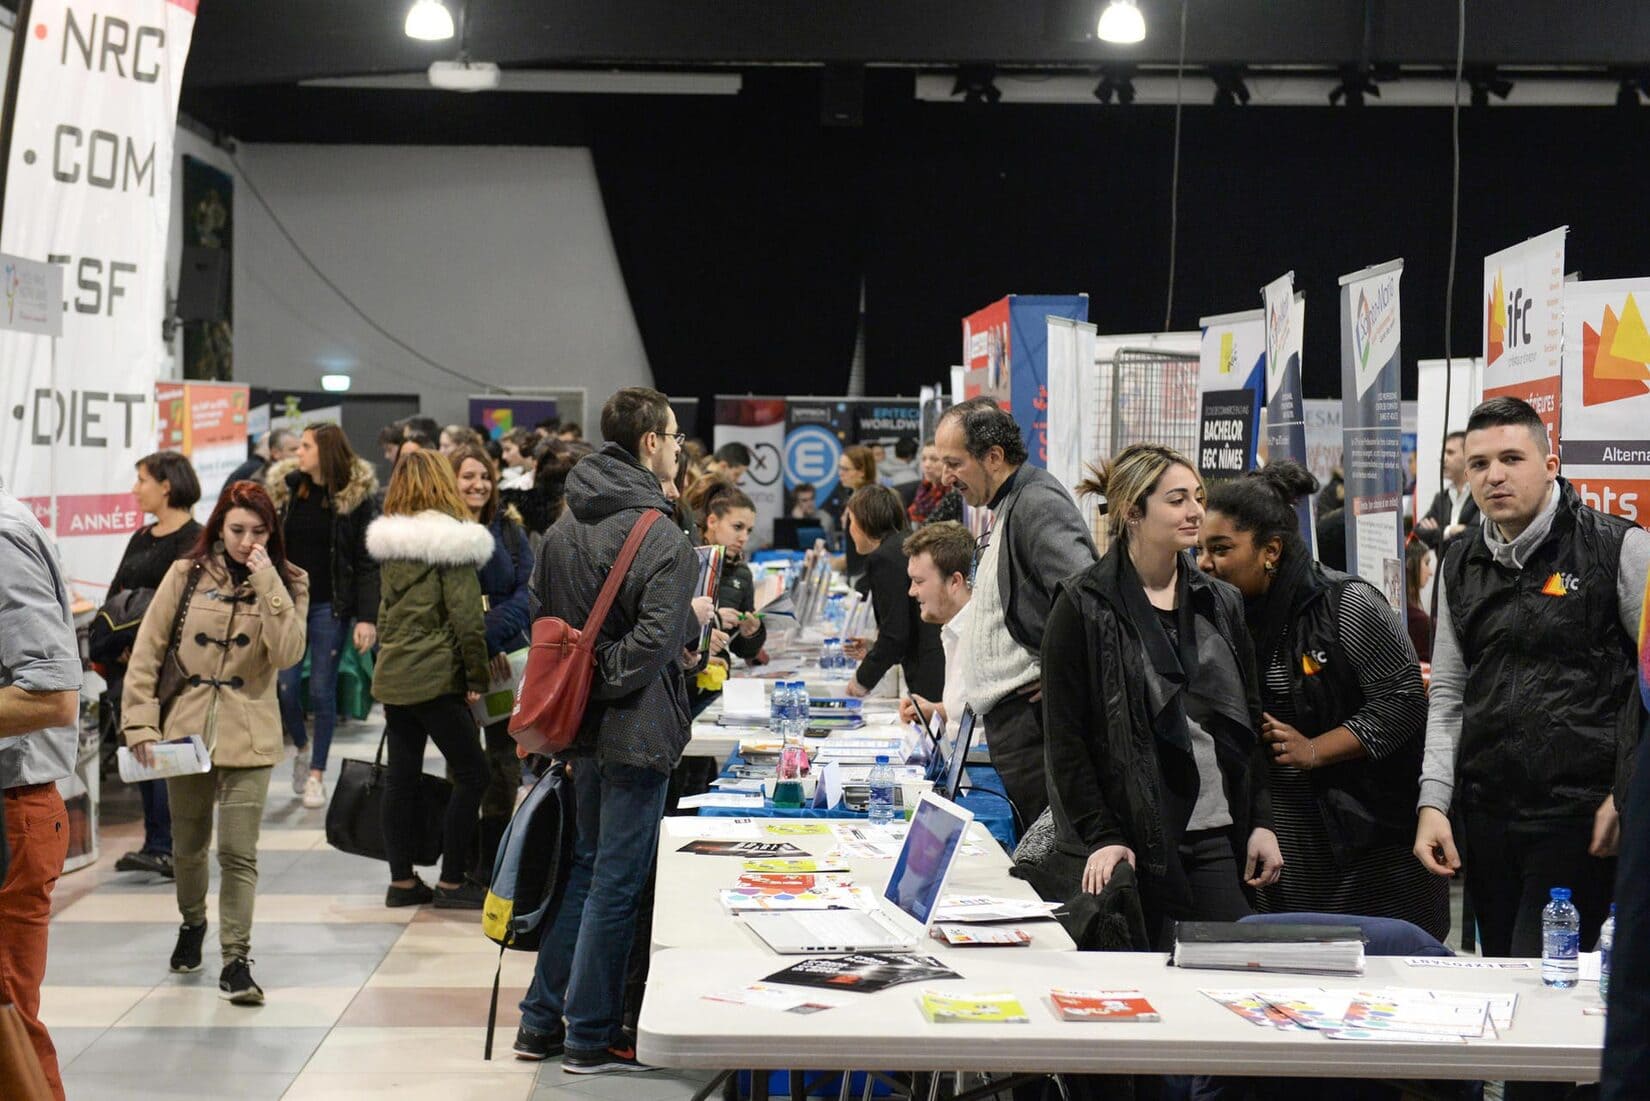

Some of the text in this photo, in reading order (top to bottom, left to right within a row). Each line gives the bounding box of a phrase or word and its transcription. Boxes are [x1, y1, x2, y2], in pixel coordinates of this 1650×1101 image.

[61, 7, 165, 84] NRC
[53, 123, 156, 197] COM
[1507, 287, 1533, 349] ifc
[31, 388, 146, 449] DIET
[1204, 420, 1244, 441] BACHELOR
[1202, 442, 1244, 471] EGC NÎMES
[69, 505, 138, 532] ANNÉE
